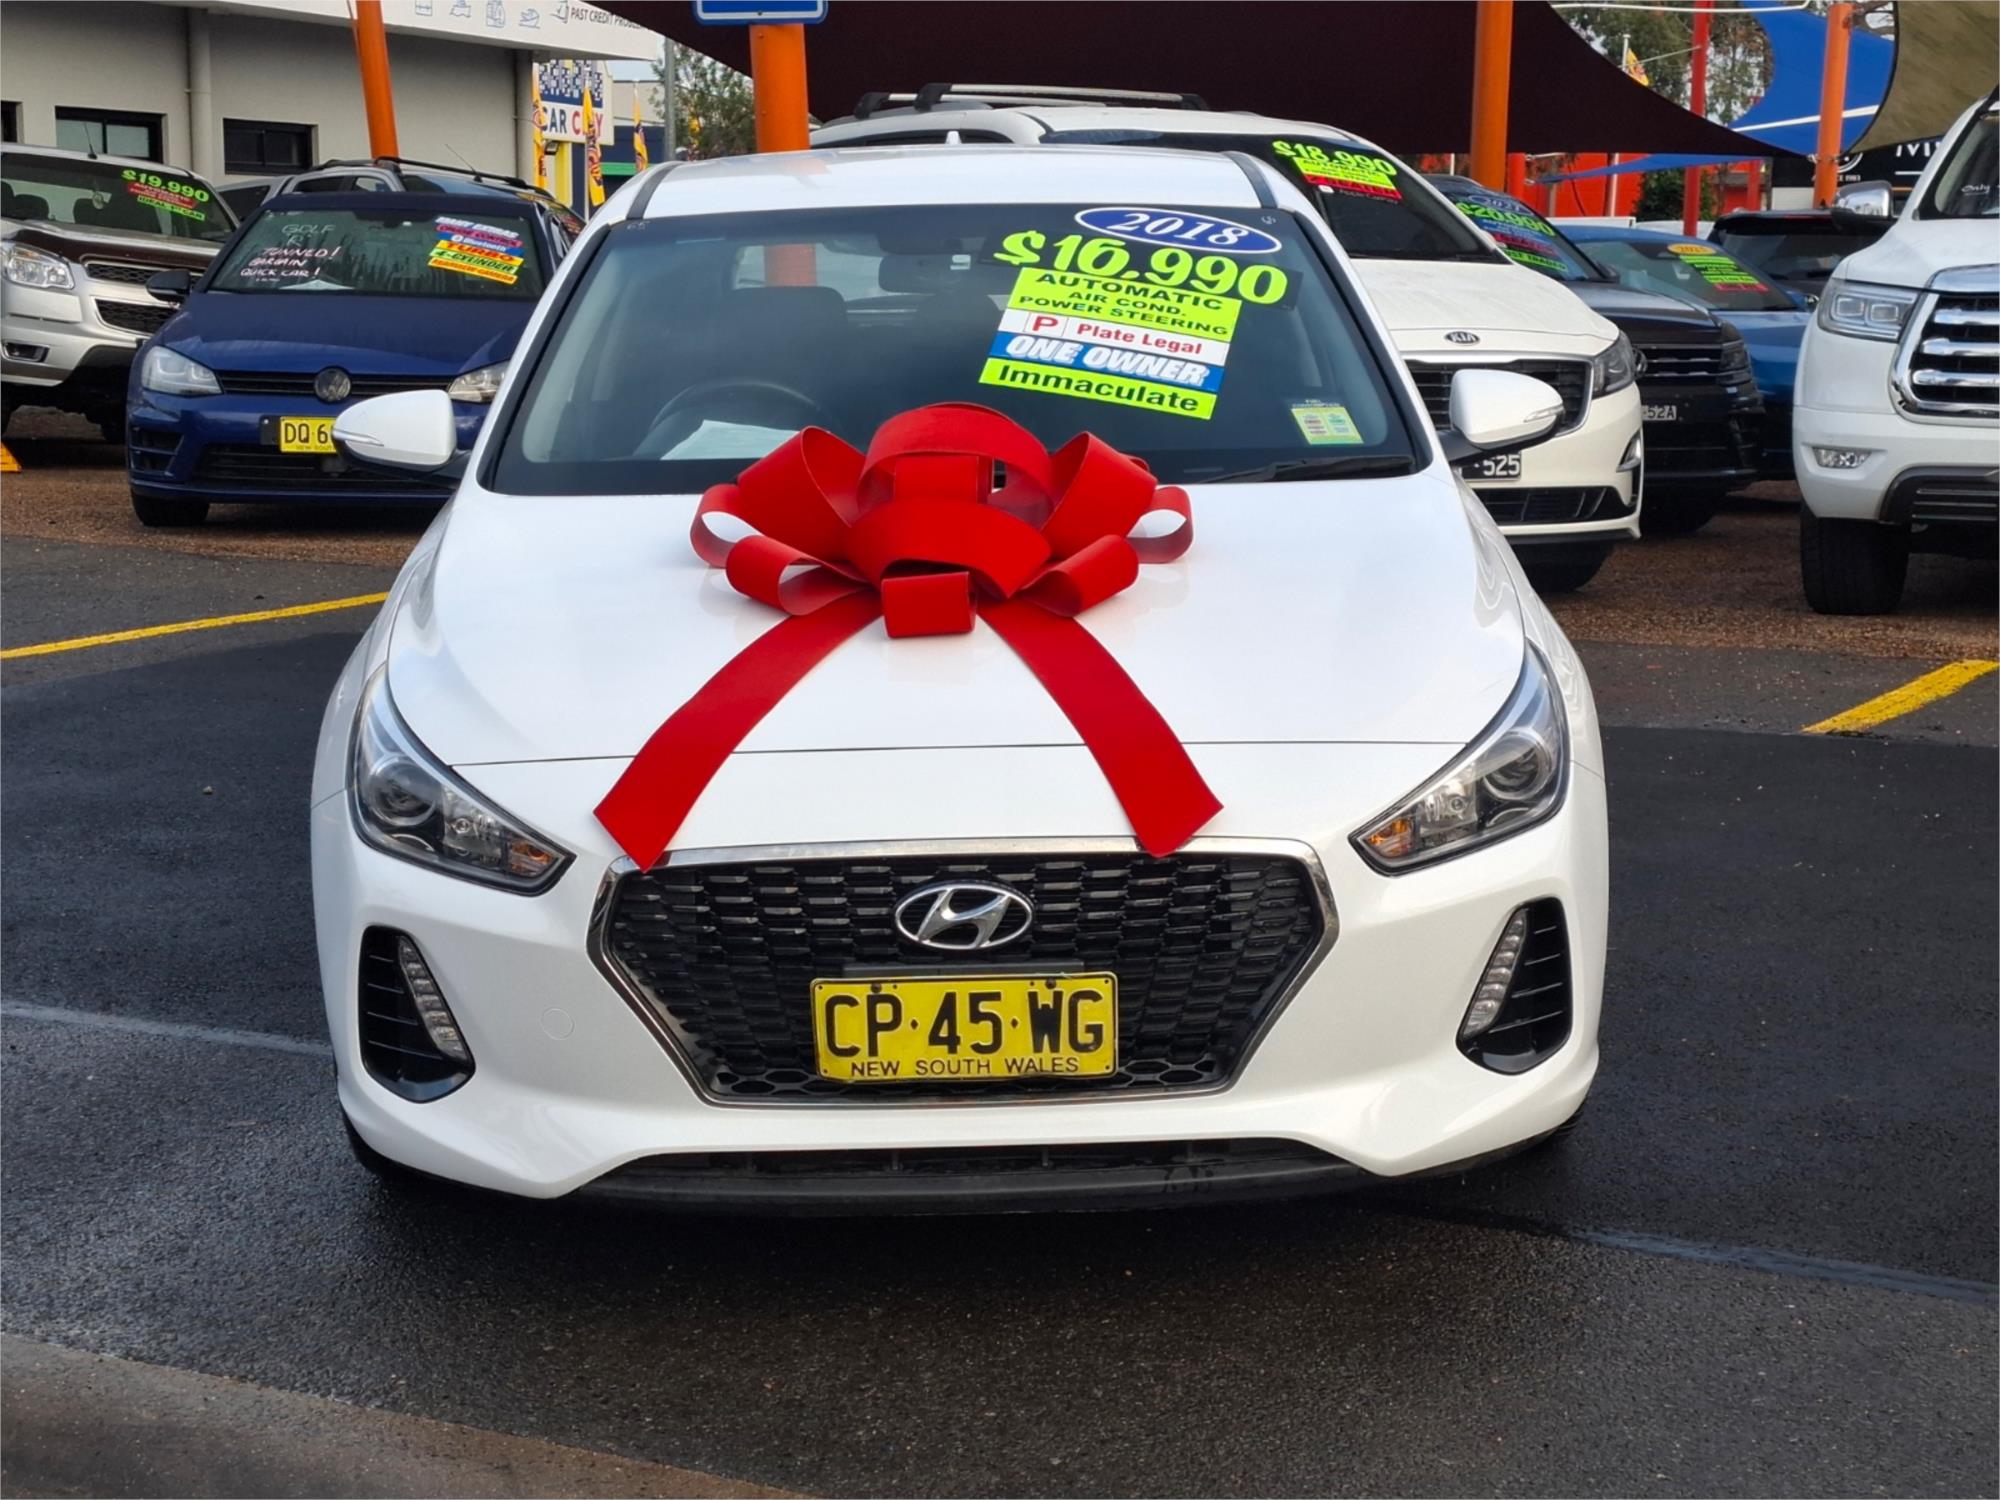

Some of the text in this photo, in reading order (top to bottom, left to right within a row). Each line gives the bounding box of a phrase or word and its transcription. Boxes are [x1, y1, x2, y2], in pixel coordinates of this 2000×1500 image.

[571, 7, 588, 21] PAST
[590, 10, 612, 25] CREDIT
[121, 169, 209, 202] $19.990
[1107, 213, 1250, 246] 2018
[437, 250, 515, 272] 4-CYLINDER
[446, 242, 514, 261] TURBO
[240, 268, 277, 277] QUICK
[1035, 273, 1224, 311] AUTOMATIC
[1068, 291, 1187, 317] AIR COND.
[1019, 295, 1229, 336] POWER STEERING
[1031, 315, 1203, 355] P Plate Legal
[1450, 332, 1476, 342] KIA
[1005, 335, 1211, 386] ONE OWNER
[998, 364, 1200, 412] Immaculate
[851, 1056, 1080, 1077] NEW SOUTH WALES
